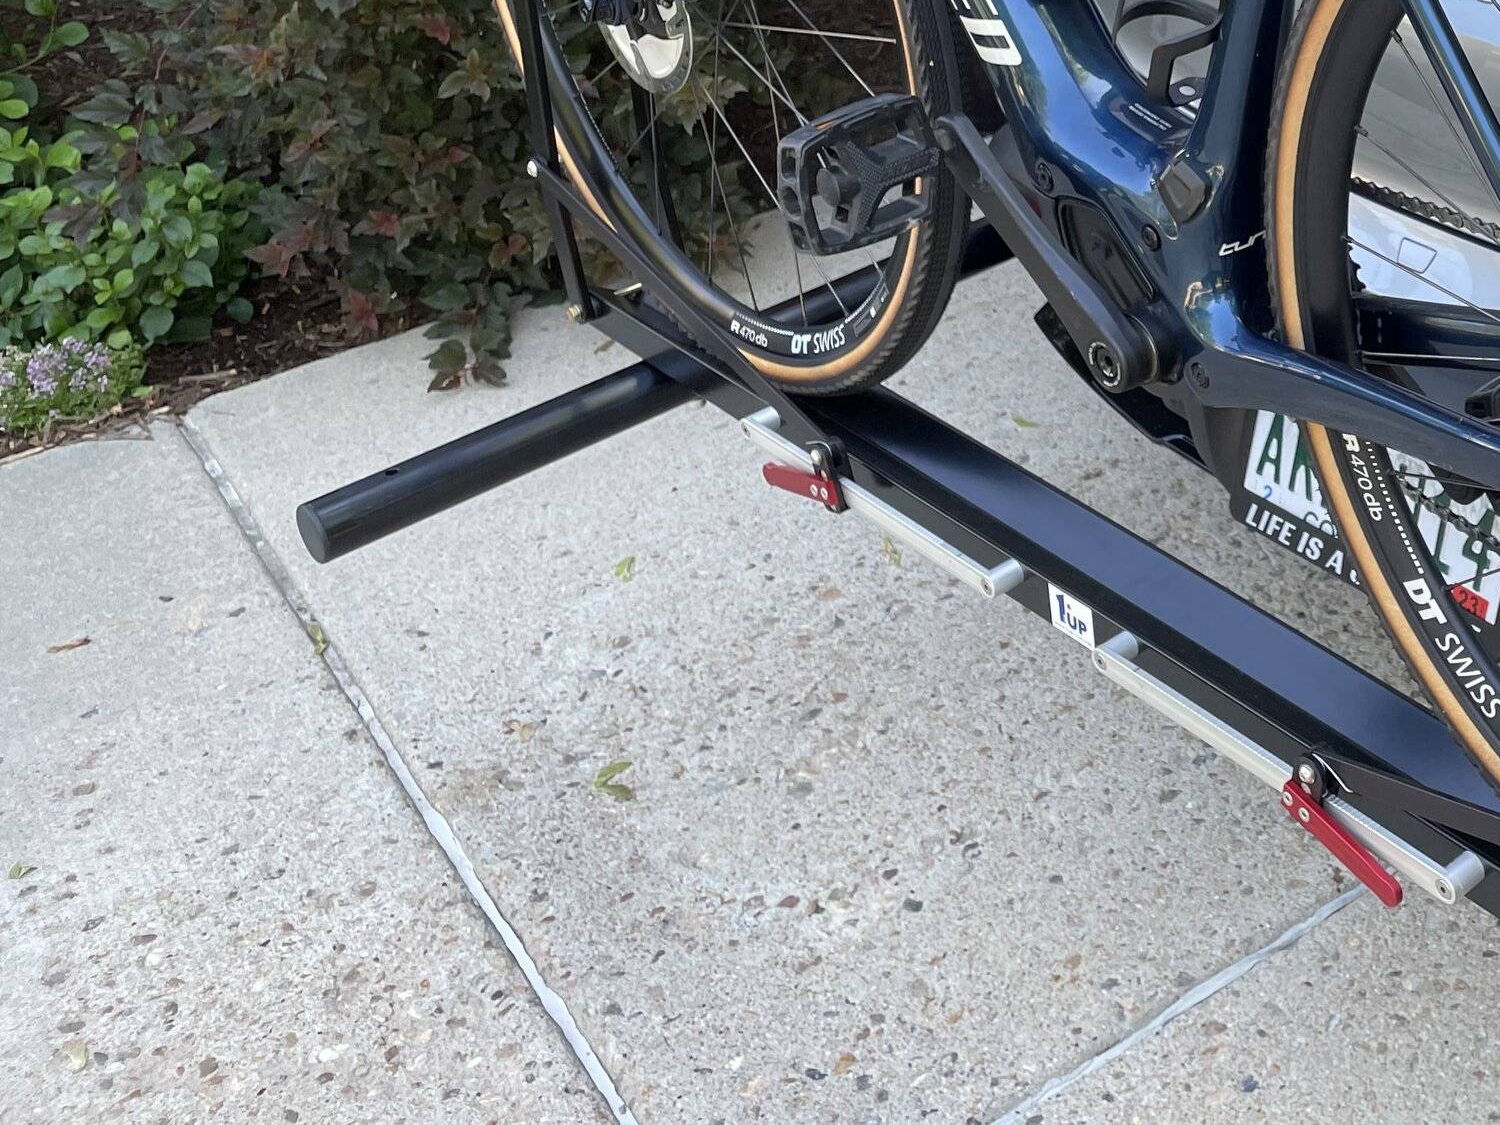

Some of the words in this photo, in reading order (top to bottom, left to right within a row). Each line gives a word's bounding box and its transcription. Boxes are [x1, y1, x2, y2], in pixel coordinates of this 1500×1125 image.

[791, 333, 812, 355] DT
[813, 324, 846, 355] SWISS
[1245, 502, 1297, 546] LIFE
[1296, 531, 1324, 561] IS
[1325, 549, 1344, 575] A
[1402, 577, 1448, 625] DT
[1458, 588, 1480, 615] 23
